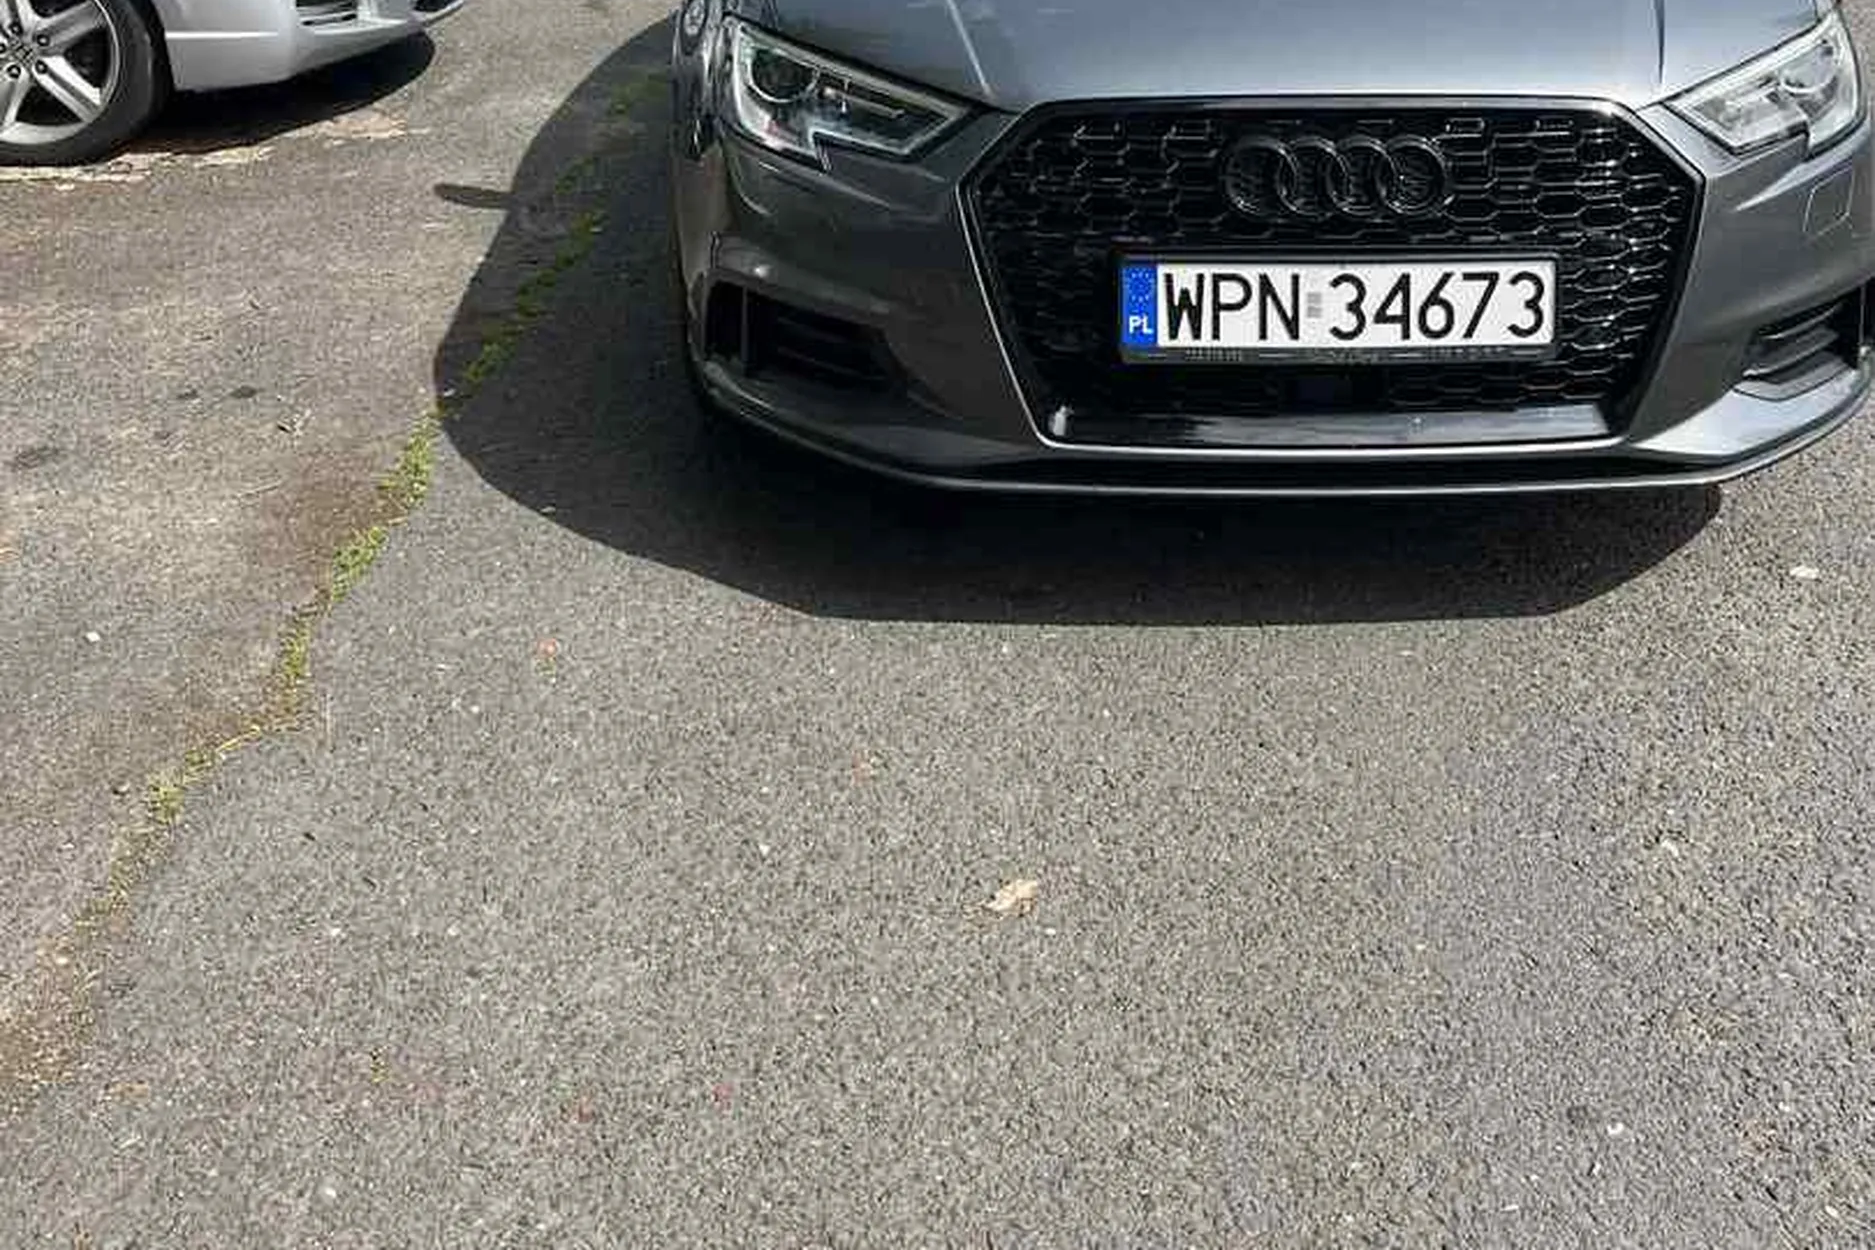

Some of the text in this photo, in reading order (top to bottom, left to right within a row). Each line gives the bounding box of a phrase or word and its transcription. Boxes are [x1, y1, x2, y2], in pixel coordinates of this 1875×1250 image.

[1128, 314, 1154, 334] PL
[1163, 270, 1545, 342] WPN 34673
